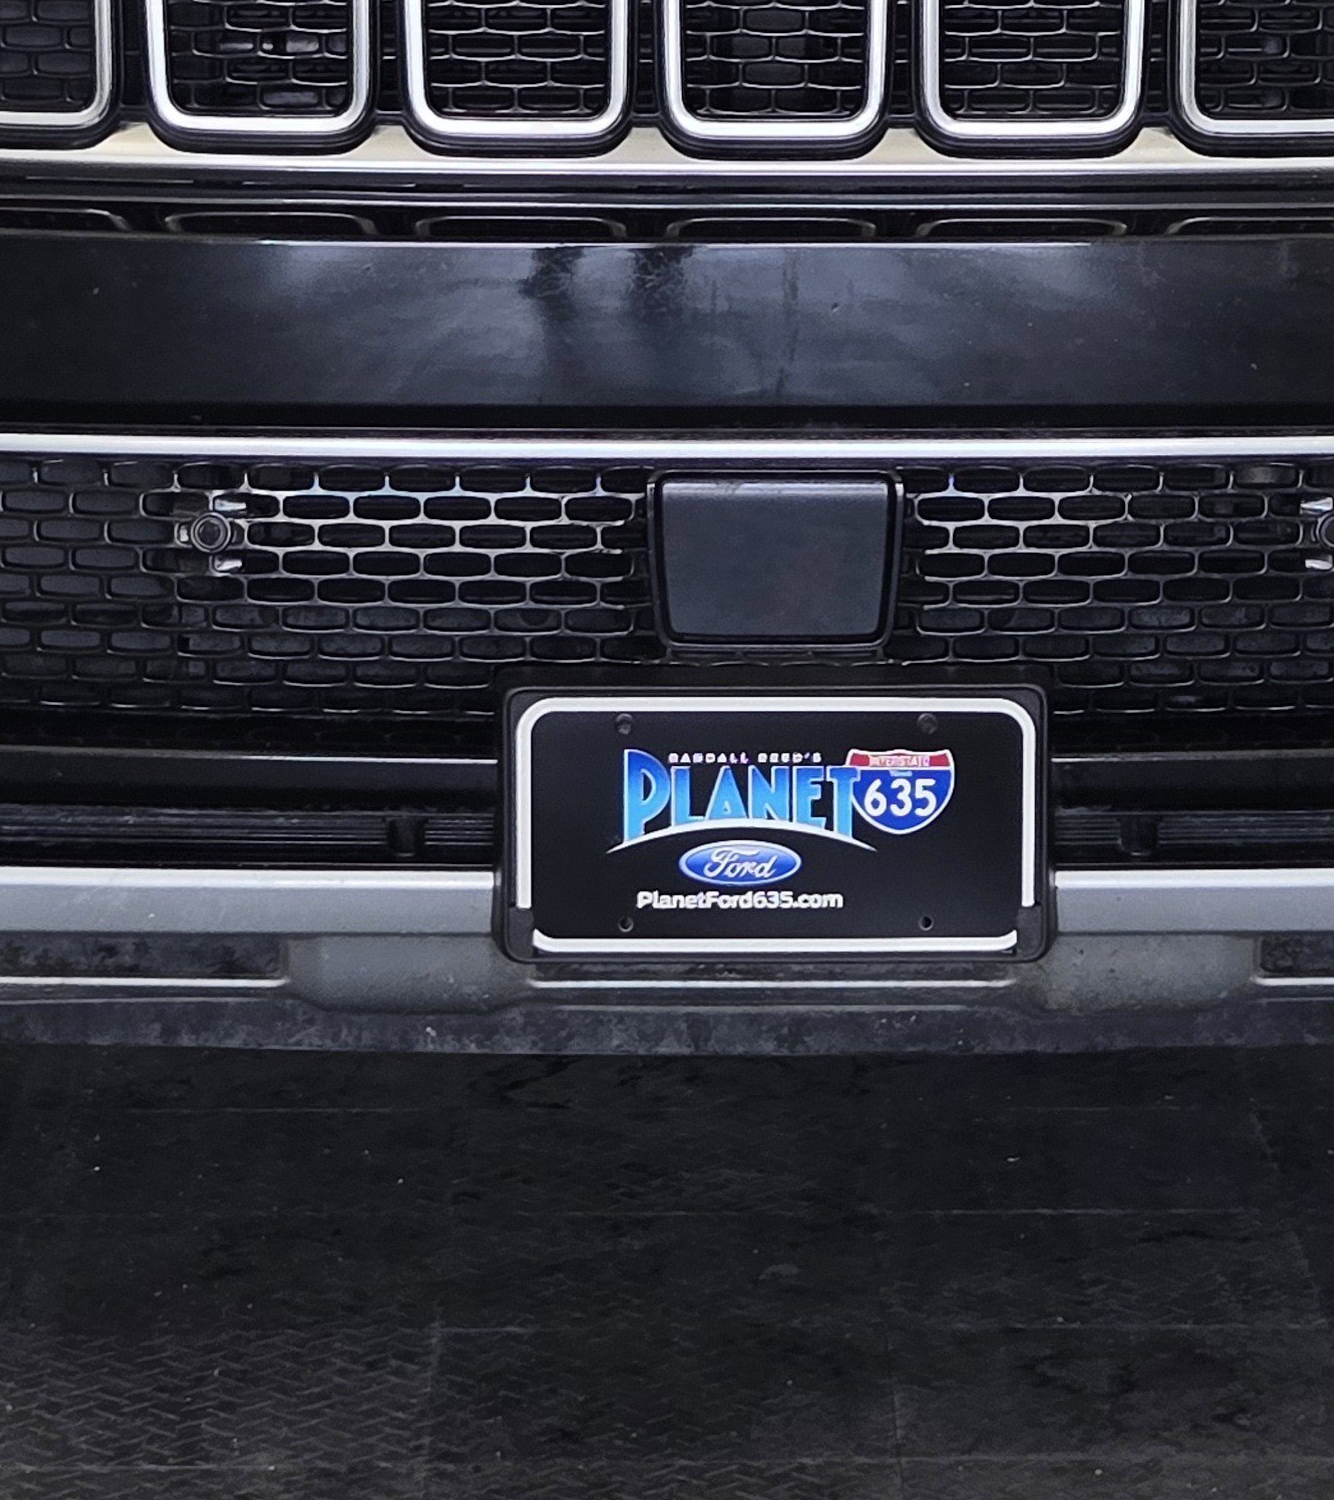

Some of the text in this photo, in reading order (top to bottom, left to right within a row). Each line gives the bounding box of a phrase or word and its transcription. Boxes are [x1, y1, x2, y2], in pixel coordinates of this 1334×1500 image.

[624, 749, 861, 840] PLANET
[864, 778, 937, 817] 635
[703, 847, 779, 879] Ford
[636, 890, 844, 910] PlanetFord635.com
